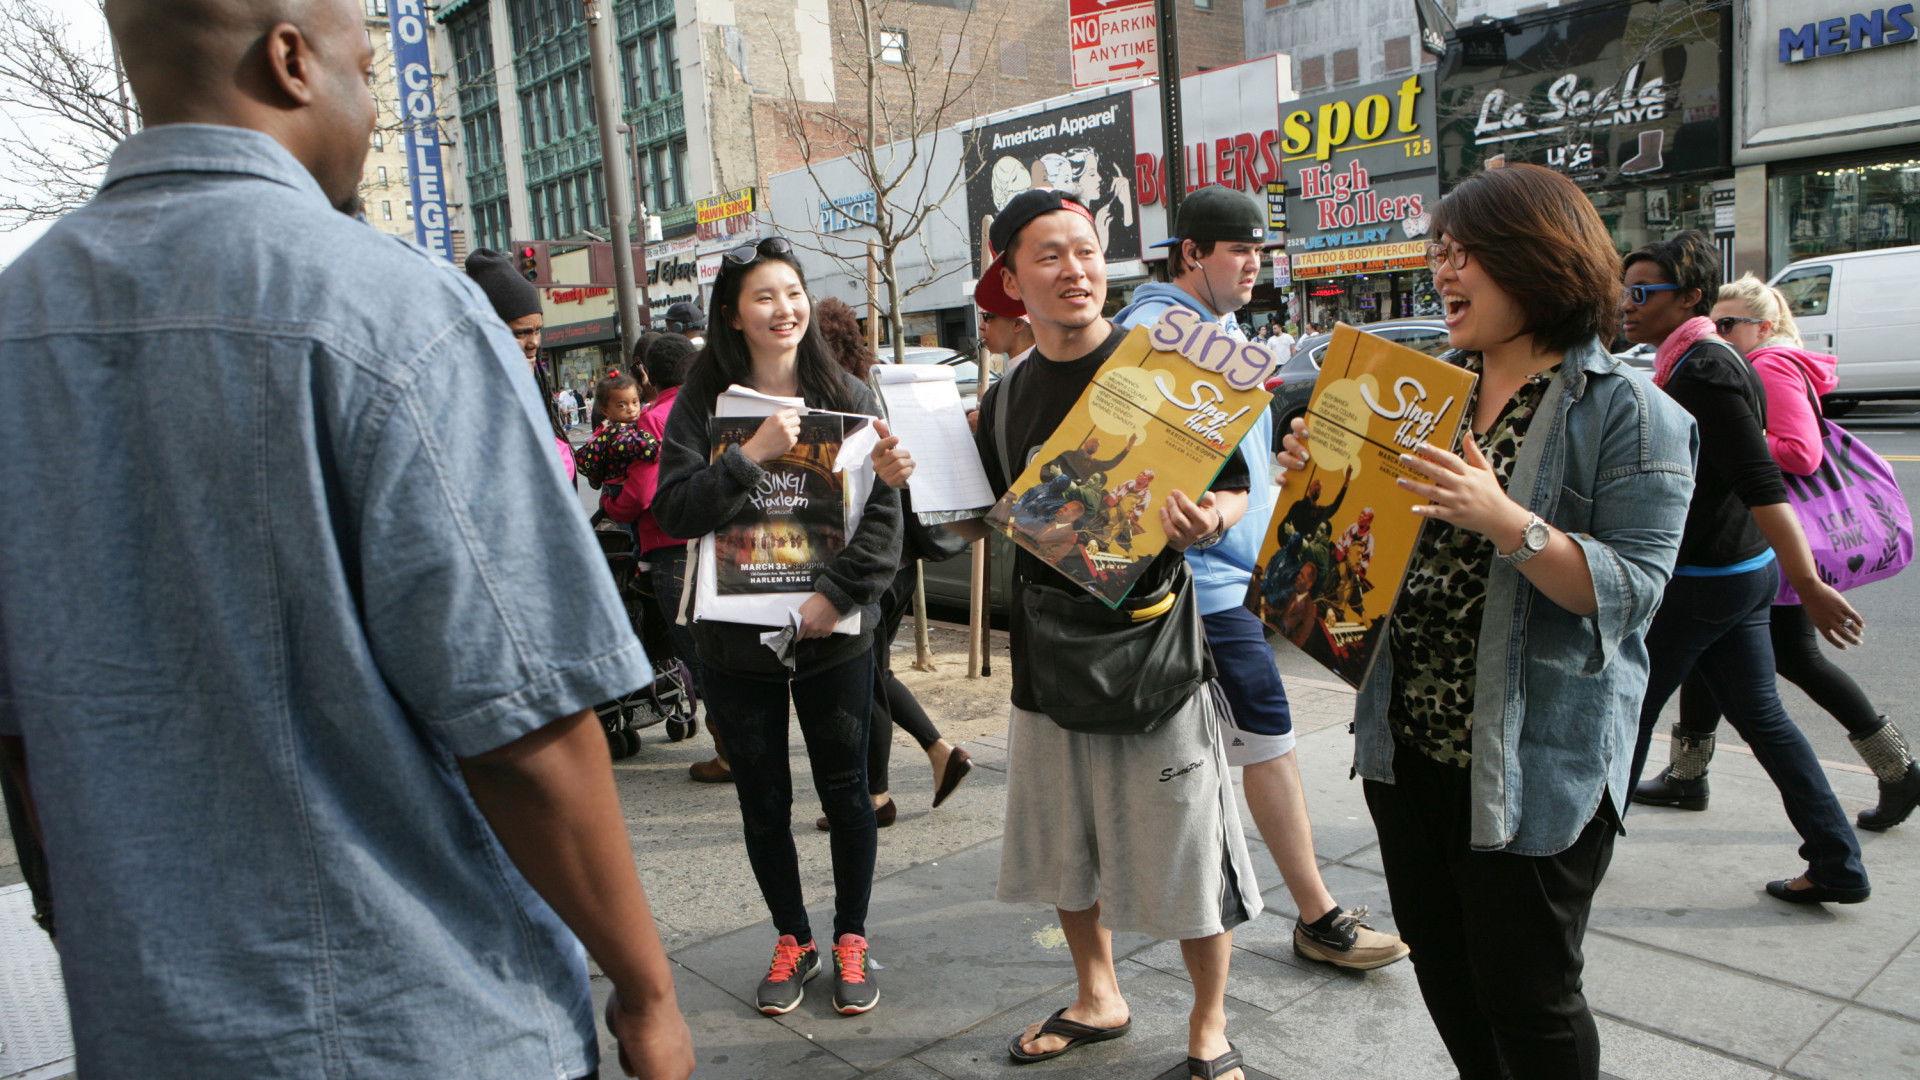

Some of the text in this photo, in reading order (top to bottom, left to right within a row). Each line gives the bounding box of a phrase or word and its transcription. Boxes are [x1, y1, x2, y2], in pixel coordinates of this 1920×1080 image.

[1072, 14, 1156, 46] NO PARKIN
[1778, 3, 1915, 63] MENS
[1089, 39, 1156, 63] ANYTIME
[1474, 60, 1667, 136] La Scala
[992, 105, 1116, 150] American Apparel
[1281, 74, 1422, 162] spot
[1613, 104, 1664, 125] NYC
[404, 62, 448, 256] COLLEGE
[1404, 138, 1431, 157] 125
[1135, 129, 1279, 208] BLLERS
[1299, 159, 1369, 203] High
[699, 200, 749, 221] PAWN SHOP
[820, 202, 877, 234] PLACE
[1316, 190, 1423, 230] Rollers
[1301, 242, 1423, 265] TATTOO & BODY PIERCING
[1304, 227, 1392, 249] JEWELRY
[701, 265, 721, 278] Hom
[1154, 310, 1271, 386] Sing
[1154, 376, 1250, 428] Sing!
[1360, 376, 1454, 435] Sing!
[1393, 420, 1430, 452] Harl
[748, 491, 808, 510] Harlem
[1819, 508, 1862, 533] LOVE
[1828, 526, 1869, 552] PINK
[786, 575, 811, 583] STAGE
